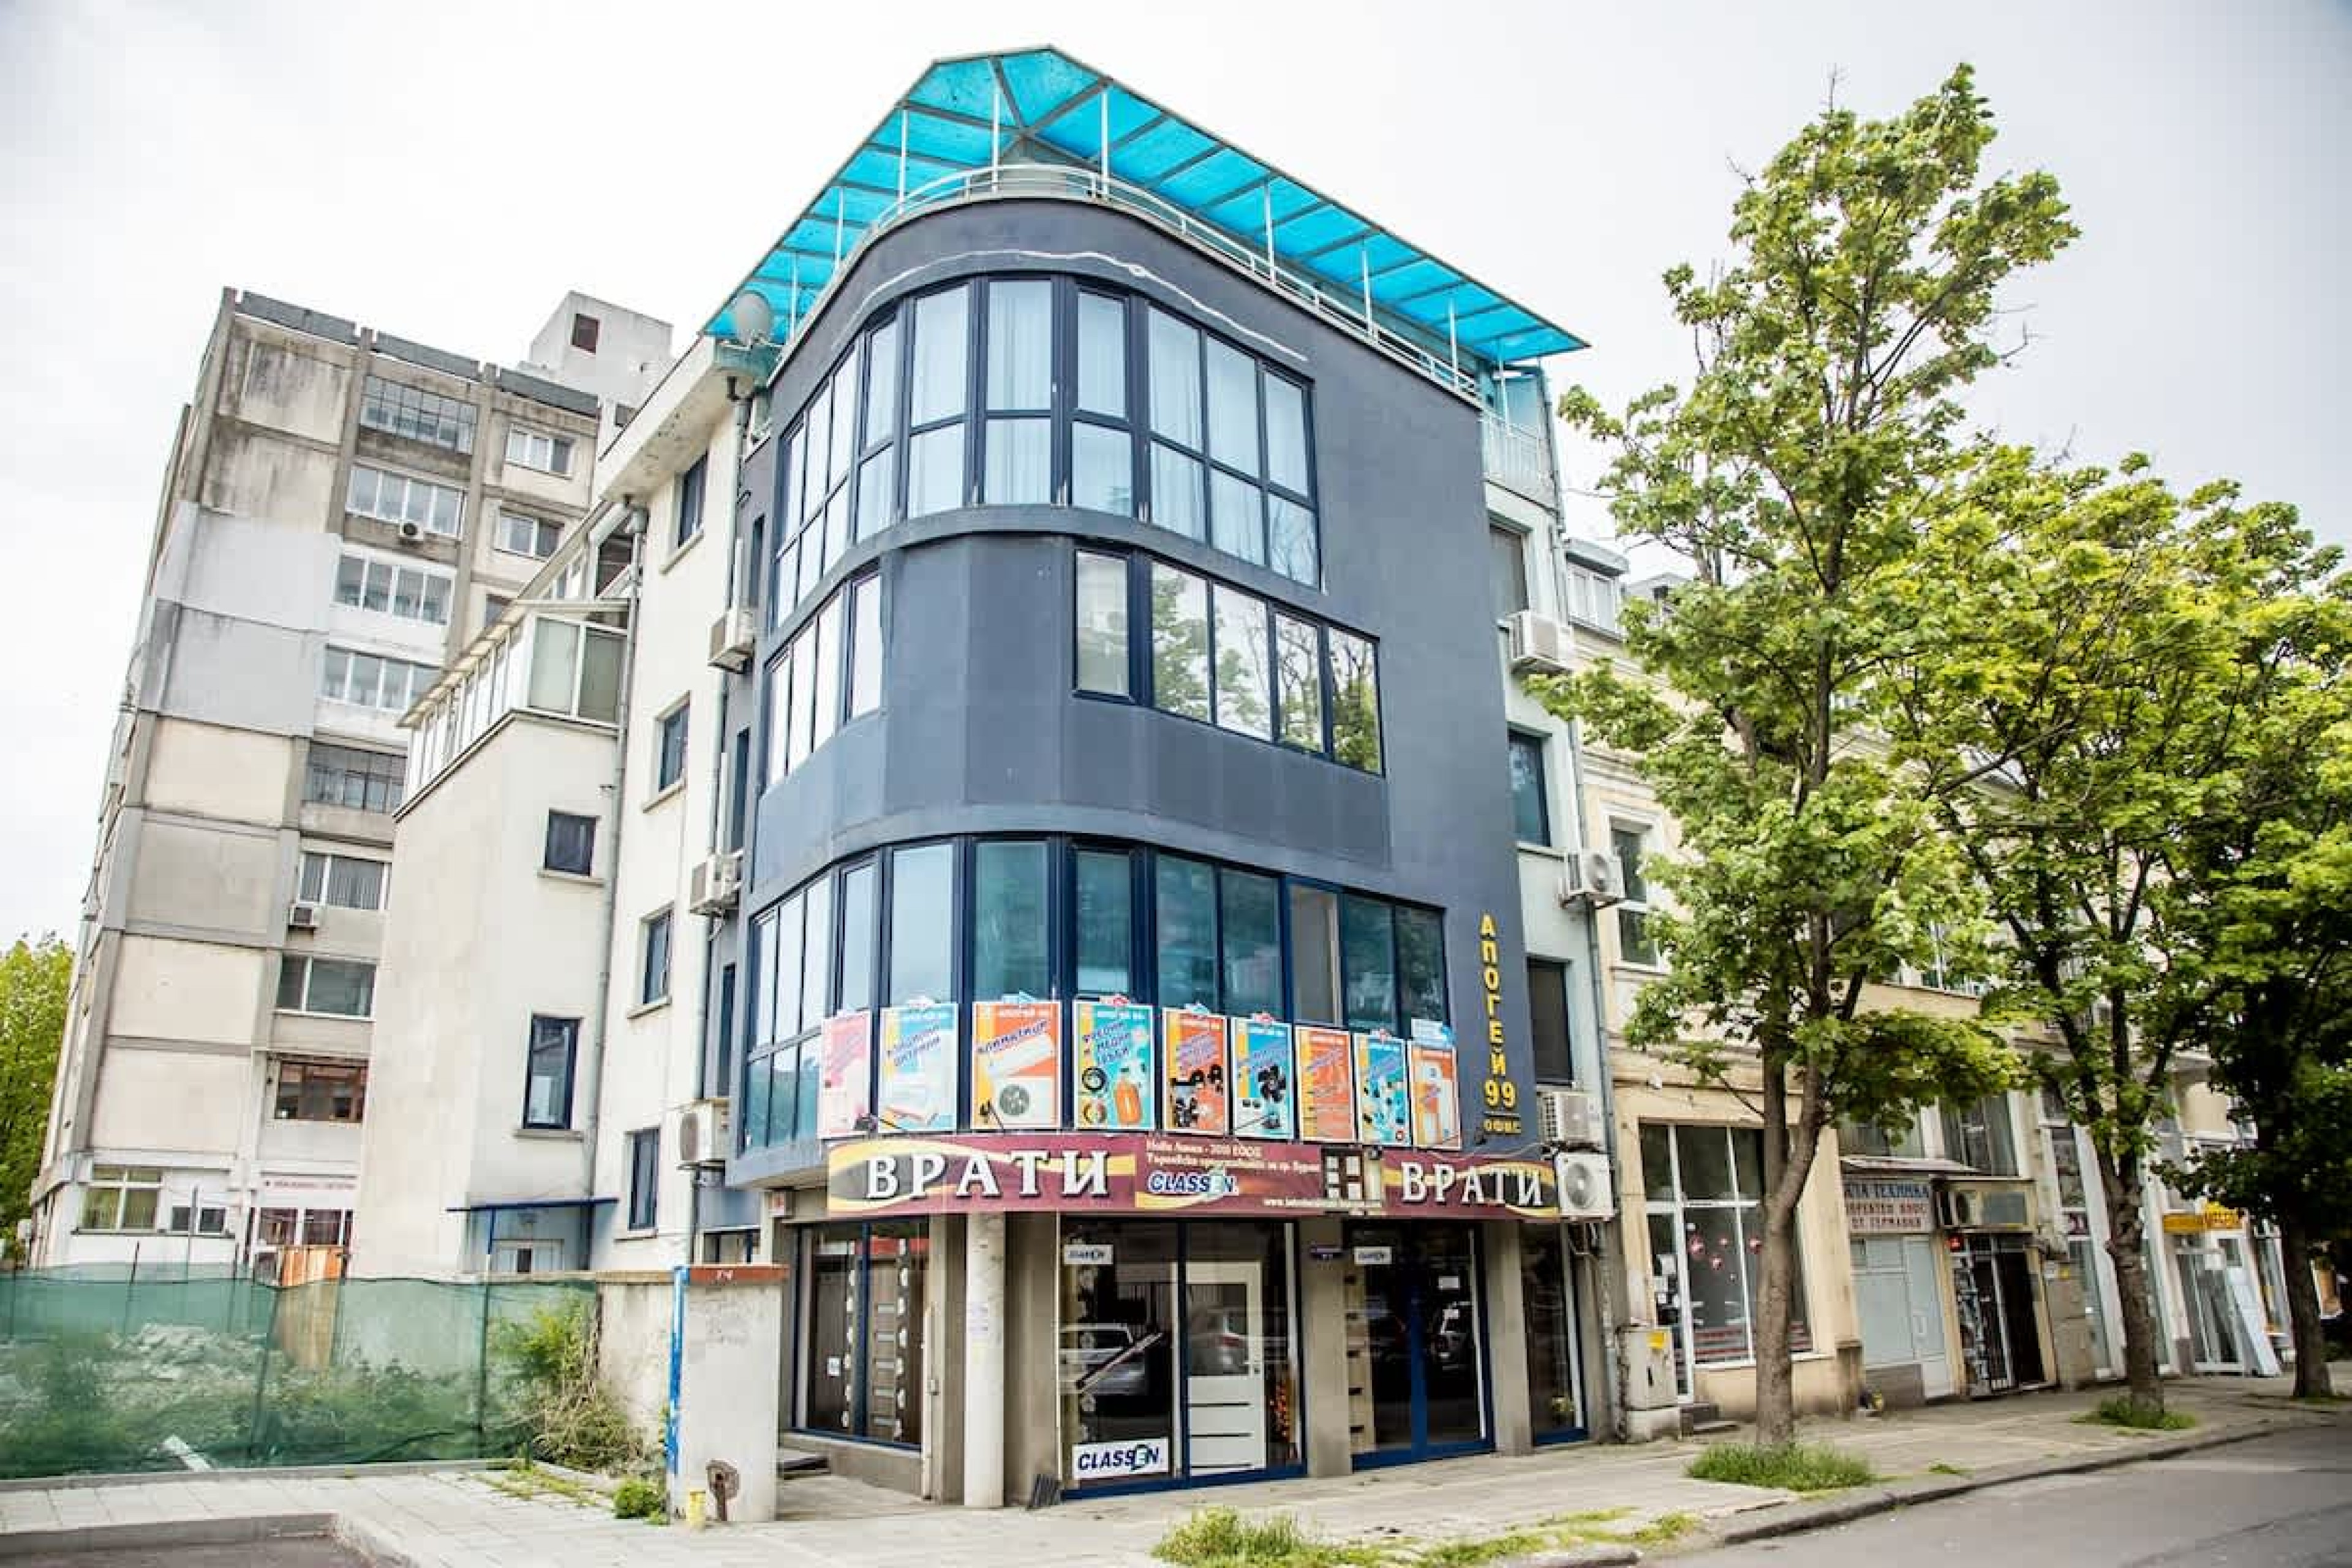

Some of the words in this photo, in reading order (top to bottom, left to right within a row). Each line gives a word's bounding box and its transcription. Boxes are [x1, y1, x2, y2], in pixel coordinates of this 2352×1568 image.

[1480, 913, 1506, 1075] АПОГЕЙ
[1484, 1079, 1516, 1107] 99
[865, 1149, 1109, 1197] ВРАТИ
[1401, 1161, 1543, 1205] ВРАТИ
[1078, 1446, 1159, 1471] CLASSEN
